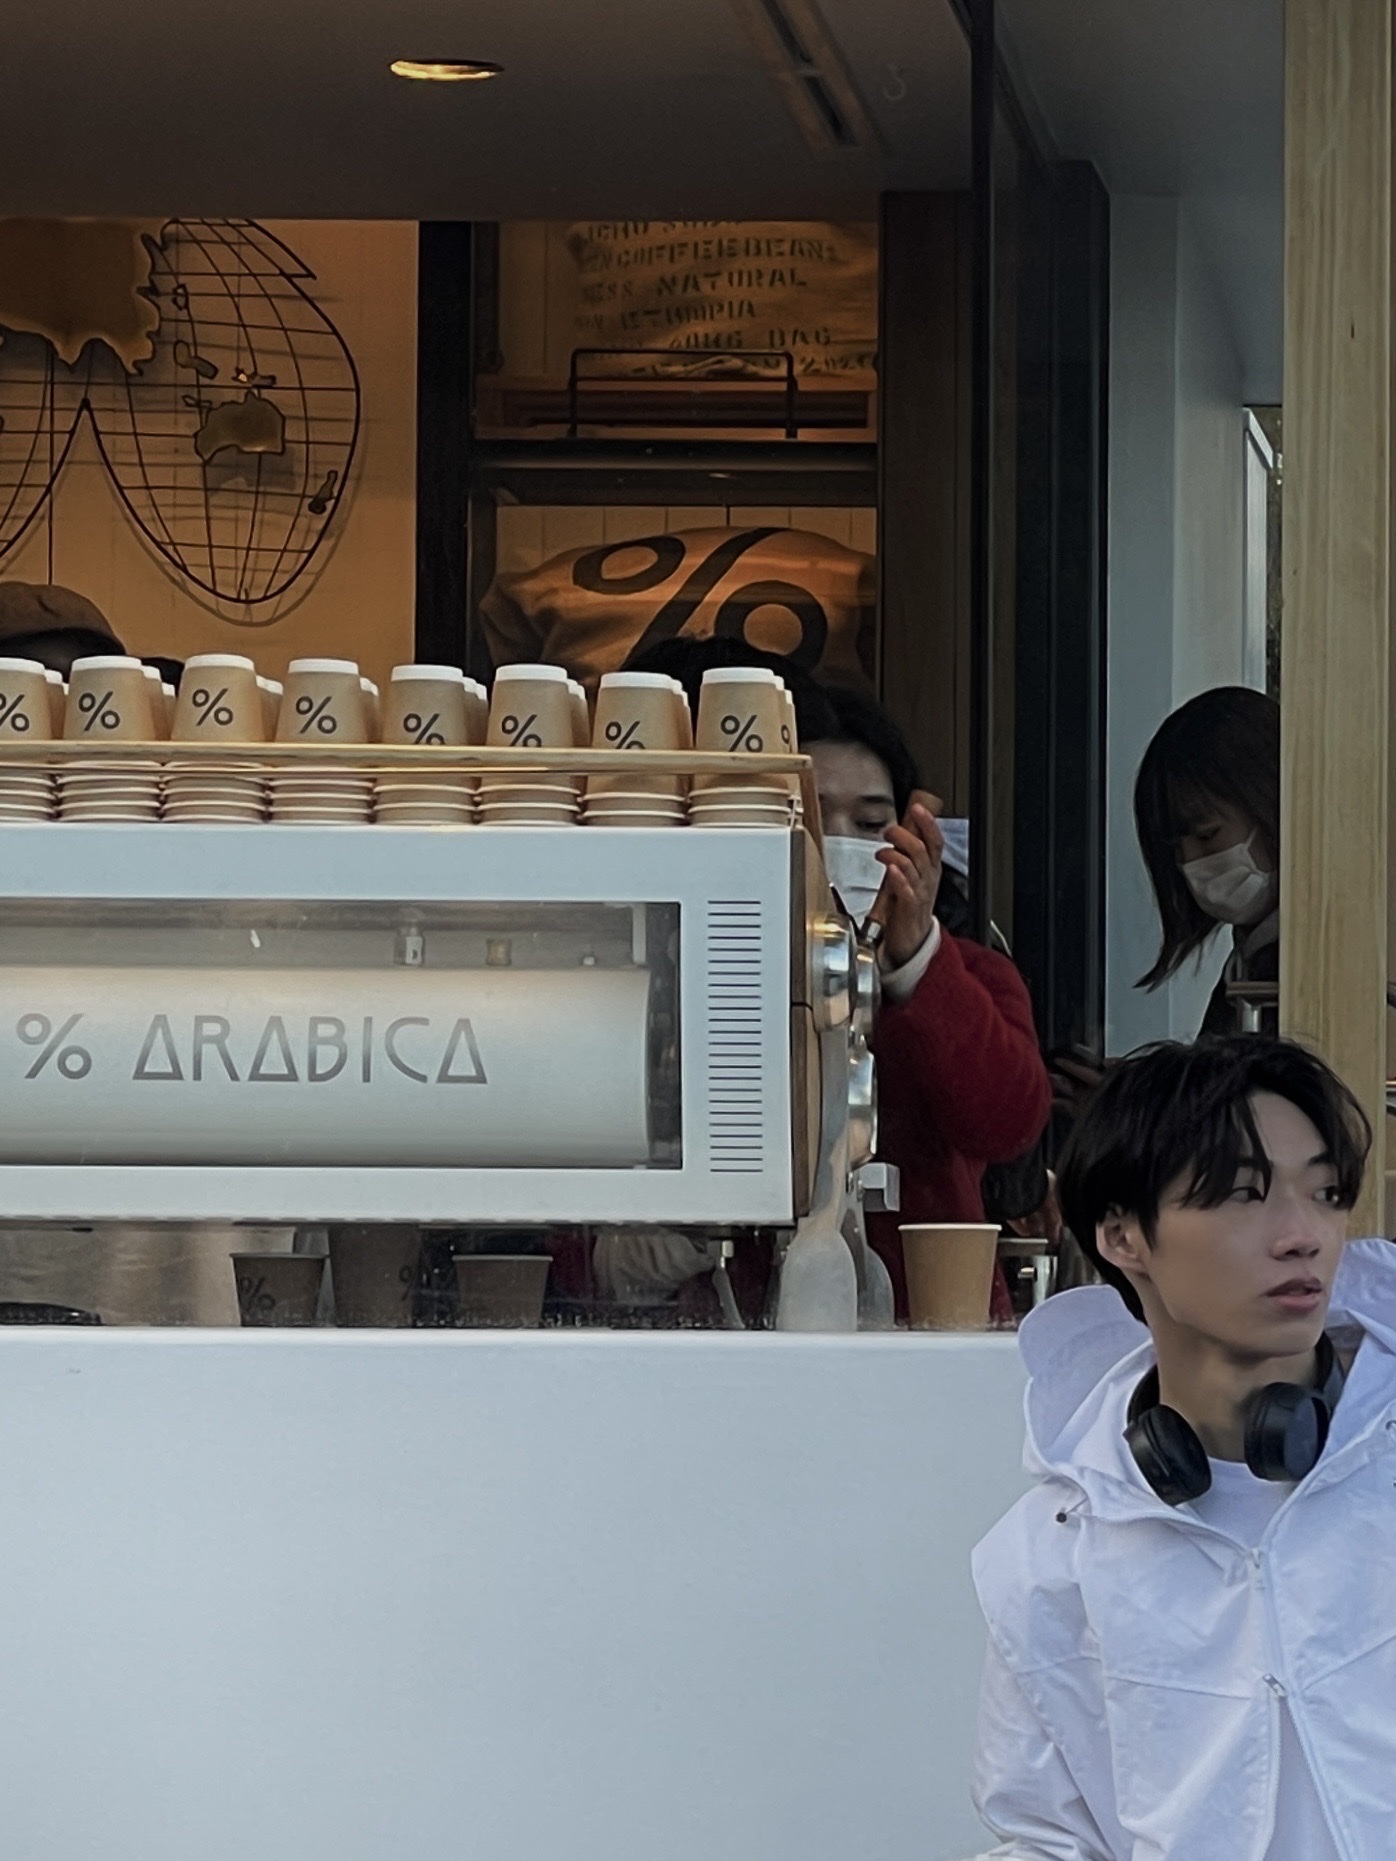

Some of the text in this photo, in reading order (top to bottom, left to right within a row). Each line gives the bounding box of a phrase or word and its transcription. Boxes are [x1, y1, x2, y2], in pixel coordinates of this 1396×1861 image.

[656, 267, 807, 297] NATURAL
[15, 1012, 489, 1085] % ARABICA
